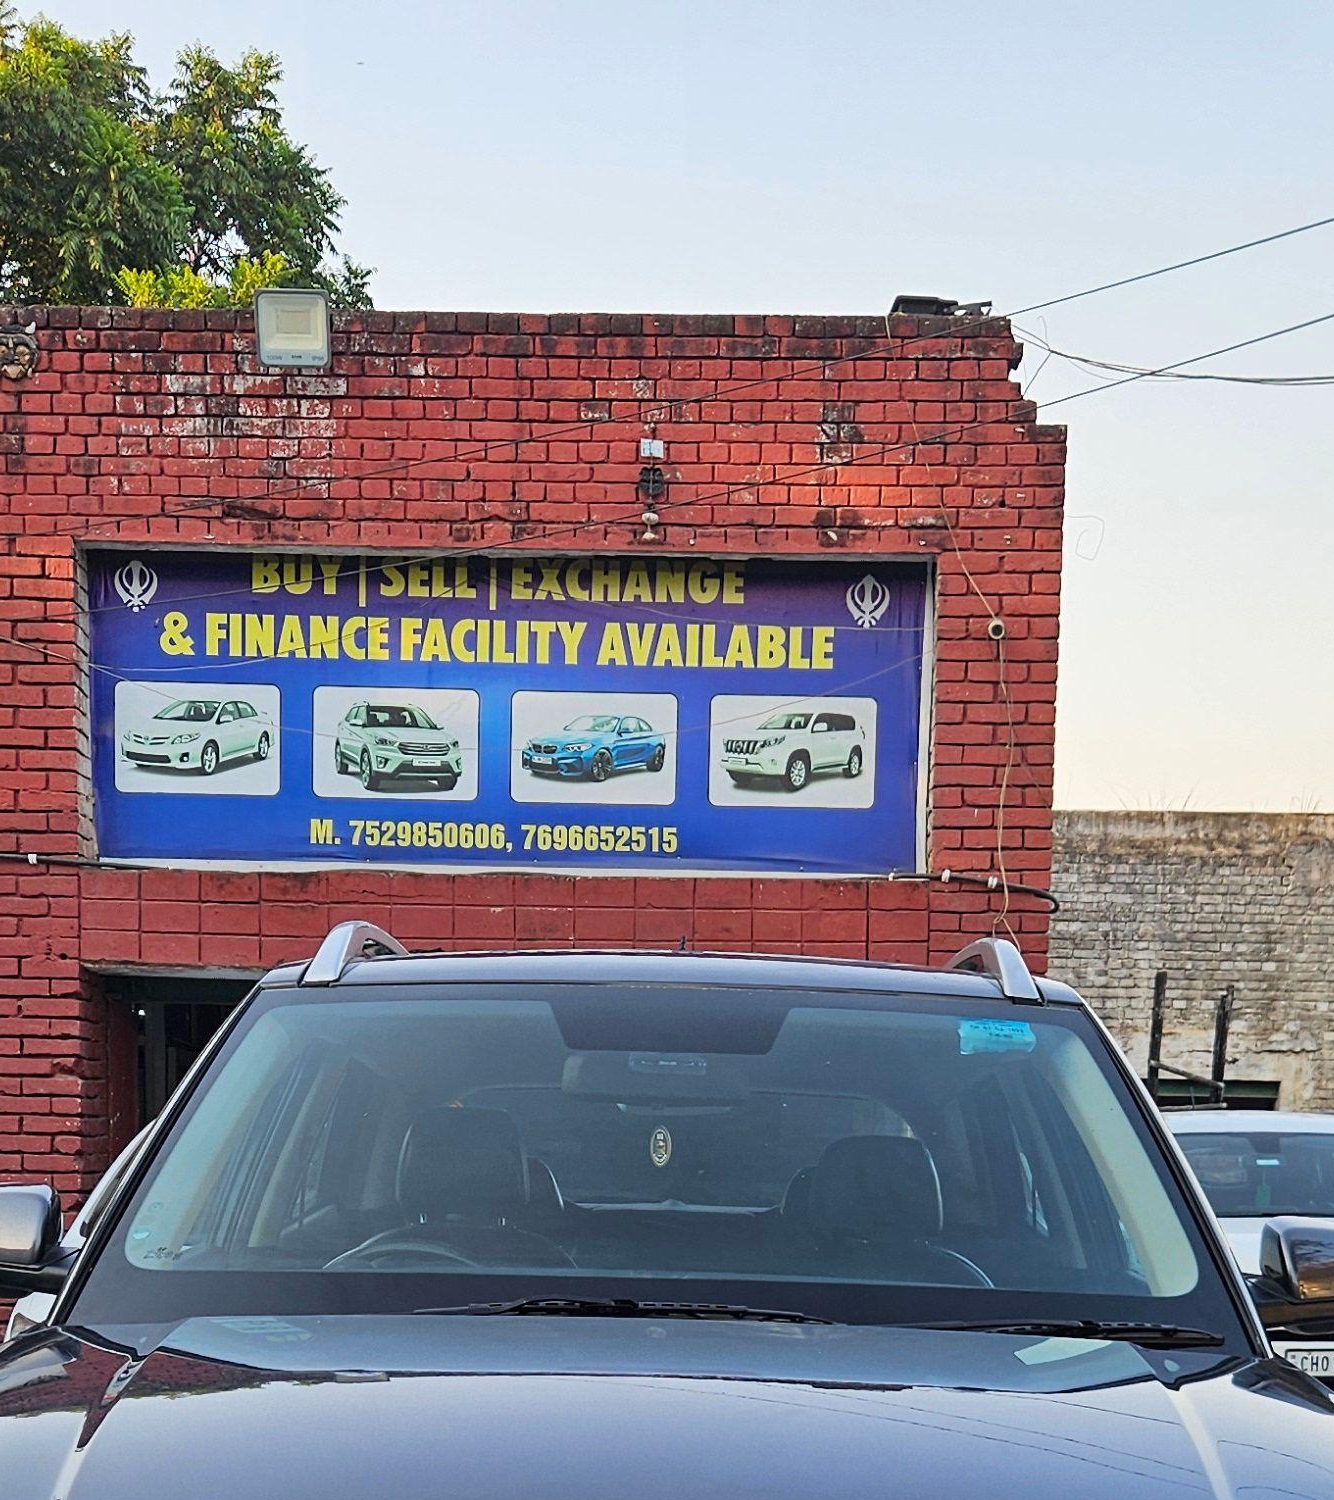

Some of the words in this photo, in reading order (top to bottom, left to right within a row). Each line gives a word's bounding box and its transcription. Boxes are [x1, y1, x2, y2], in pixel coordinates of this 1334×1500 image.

[252, 554, 344, 595] BUY
[380, 556, 476, 598] SELL
[511, 558, 745, 604] EXCHANGE
[159, 611, 195, 656] &
[206, 612, 389, 660] FINANCE
[400, 617, 587, 665] FACILITY
[596, 622, 835, 669] AVAILABLE
[310, 818, 340, 844] M.
[348, 820, 513, 853] 7529850606,
[521, 824, 678, 853] 7696652515
